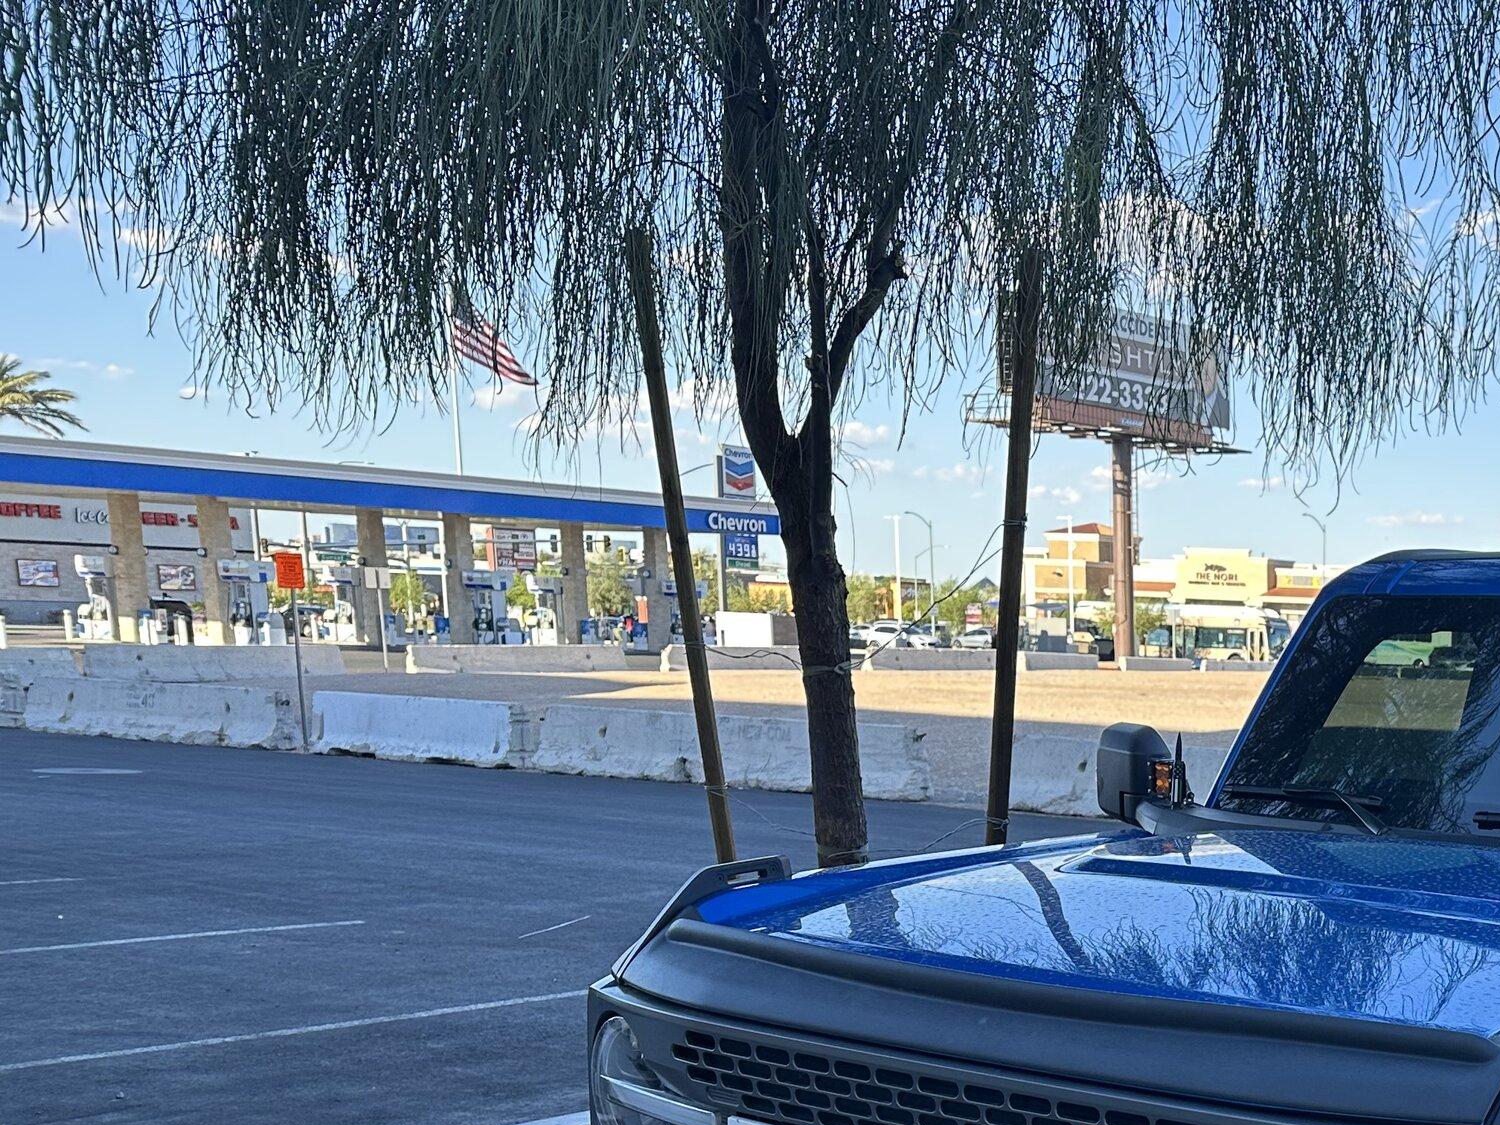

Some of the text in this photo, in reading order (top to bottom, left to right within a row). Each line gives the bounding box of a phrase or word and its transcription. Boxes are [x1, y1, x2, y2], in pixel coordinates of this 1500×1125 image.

[725, 448, 752, 459] Chevron
[708, 512, 767, 532] Chevron
[1214, 573, 1238, 582] NORI
